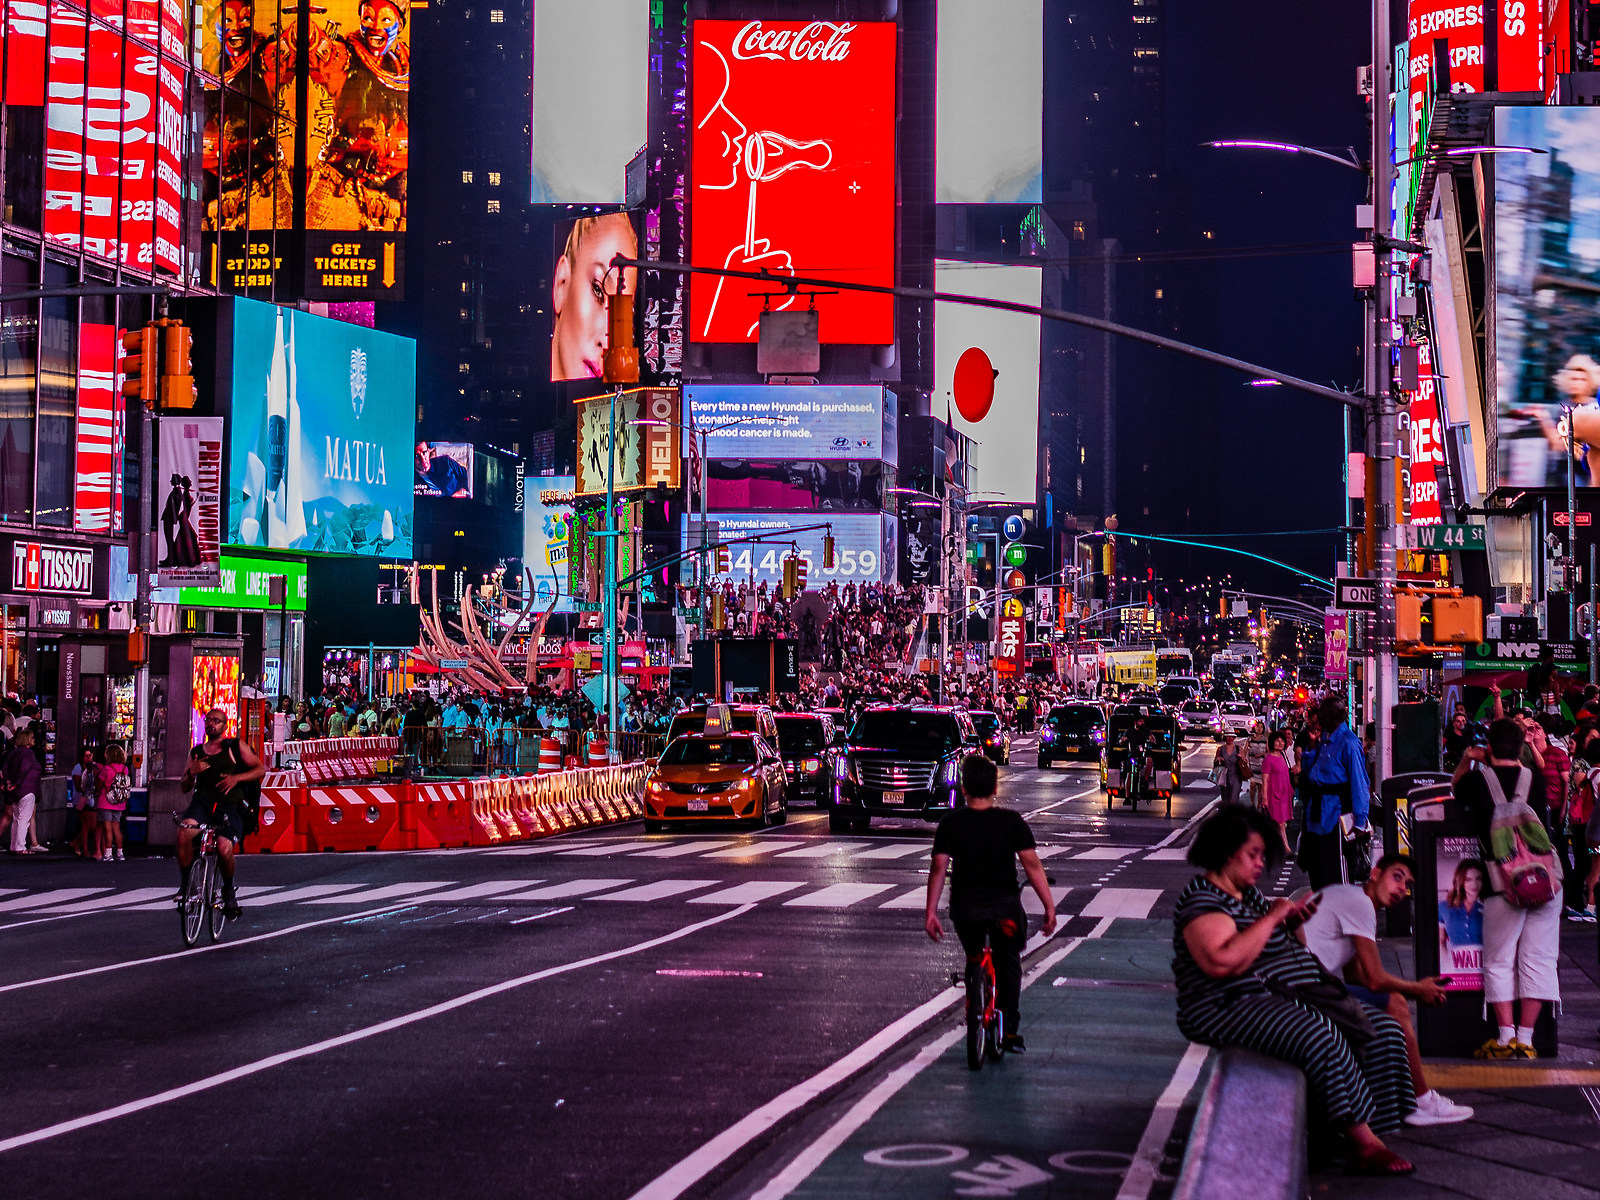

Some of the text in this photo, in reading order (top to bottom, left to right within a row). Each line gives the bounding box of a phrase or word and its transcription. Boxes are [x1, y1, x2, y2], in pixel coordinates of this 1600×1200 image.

[331, 243, 361, 256] GET
[315, 257, 376, 270] TICKETS
[322, 274, 368, 287] HERE!
[691, 402, 717, 413] Every
[718, 401, 740, 411] time
[749, 404, 770, 412] new
[771, 402, 811, 414] Hyundai
[813, 402, 821, 412] is
[822, 403, 875, 415] purchased,
[699, 414, 741, 424] donation
[652, 392, 672, 482] HELLO!
[739, 428, 812, 438] cancer is made.
[199, 441, 220, 494] PRETTY
[324, 435, 387, 486] MATUA
[515, 461, 524, 513] NOVOTEL
[540, 490, 558, 500] HERE
[623, 507, 631, 543] OLIVE
[726, 520, 759, 530] Hyundai
[760, 521, 790, 529] owners,
[572, 519, 580, 553] OLIVE
[1421, 527, 1483, 546] W 44 St
[42, 548, 92, 591] TISSOT
[246, 571, 261, 596] LINE
[1350, 588, 1376, 601] ONE
[588, 602, 596, 611] 45
[51, 611, 71, 625] TISSOT
[1001, 619, 1021, 658] tkts
[505, 644, 562, 654] NYC DOGS
[1497, 642, 1540, 658] NYC
[1444, 845, 1464, 853] NOW
